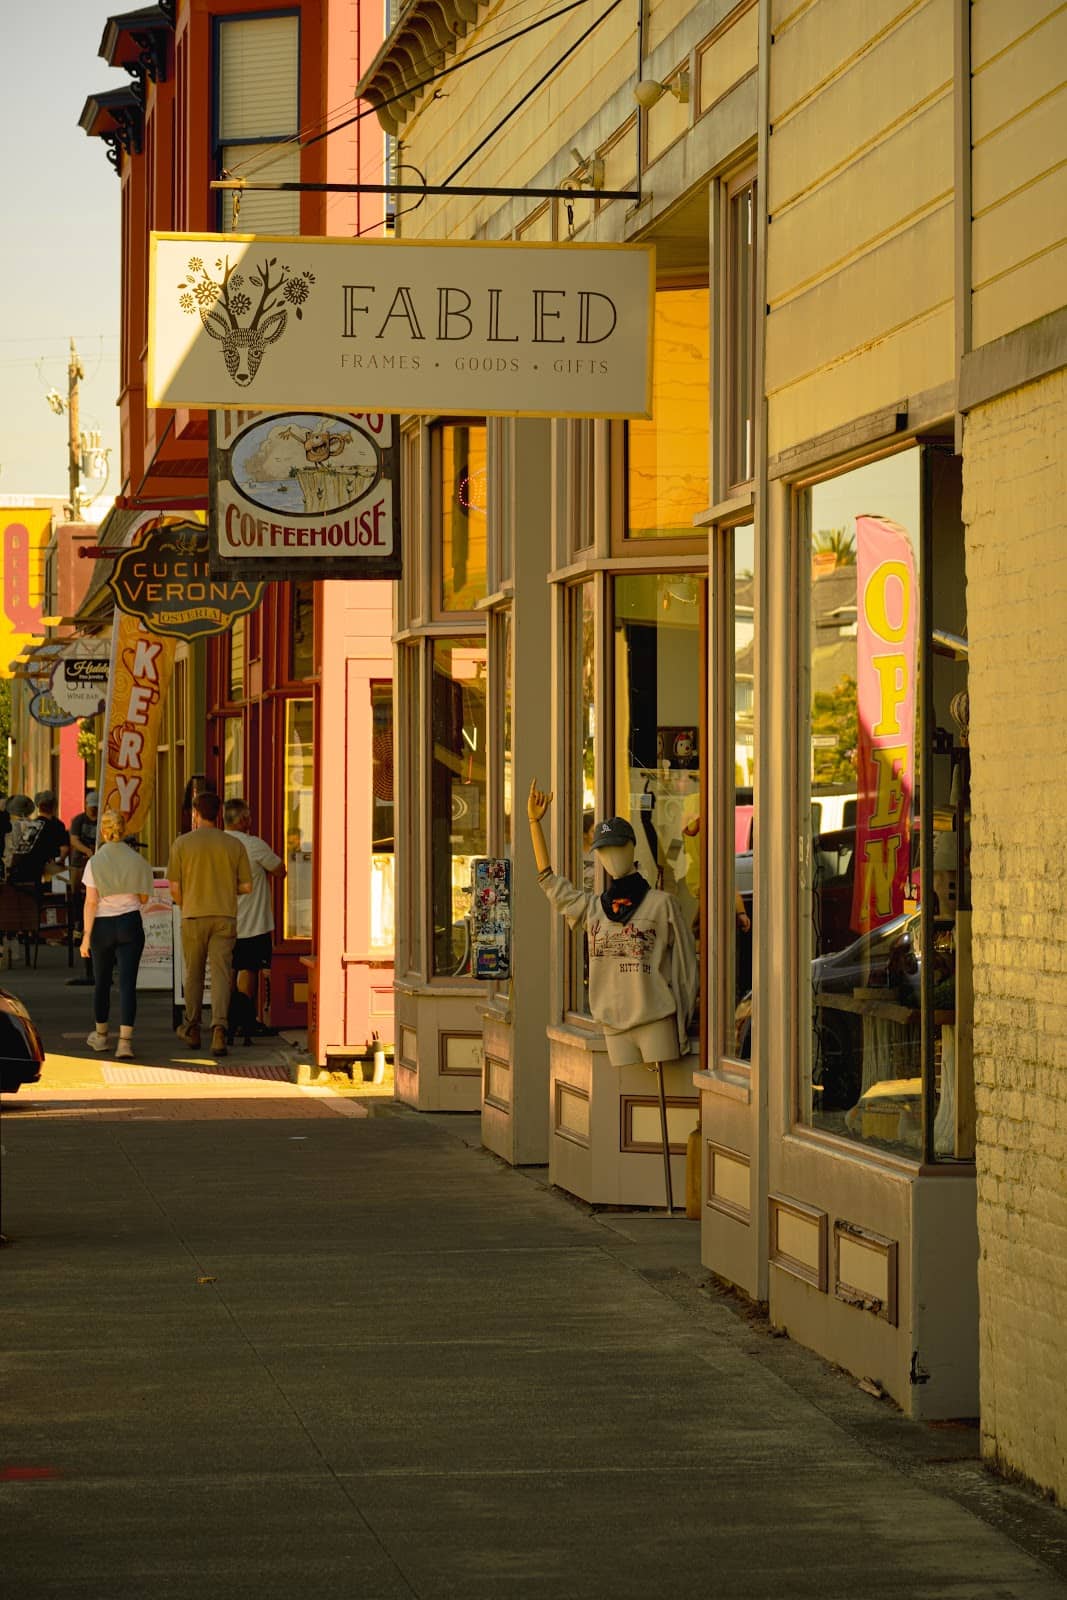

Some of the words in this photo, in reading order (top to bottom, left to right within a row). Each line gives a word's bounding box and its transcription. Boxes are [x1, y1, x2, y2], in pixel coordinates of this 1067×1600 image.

[340, 284, 618, 345] FABLED
[340, 355, 421, 370] FRAMES
[455, 357, 520, 373] GOODS
[553, 360, 609, 375] GIFTS
[225, 498, 386, 547] COFFEEHOUSE
[133, 562, 209, 578] CUCI
[123, 581, 251, 601] VERONA
[162, 608, 218, 621] OSTERIA
[115, 622, 163, 813] KERY
[861, 561, 911, 920] OPEN
